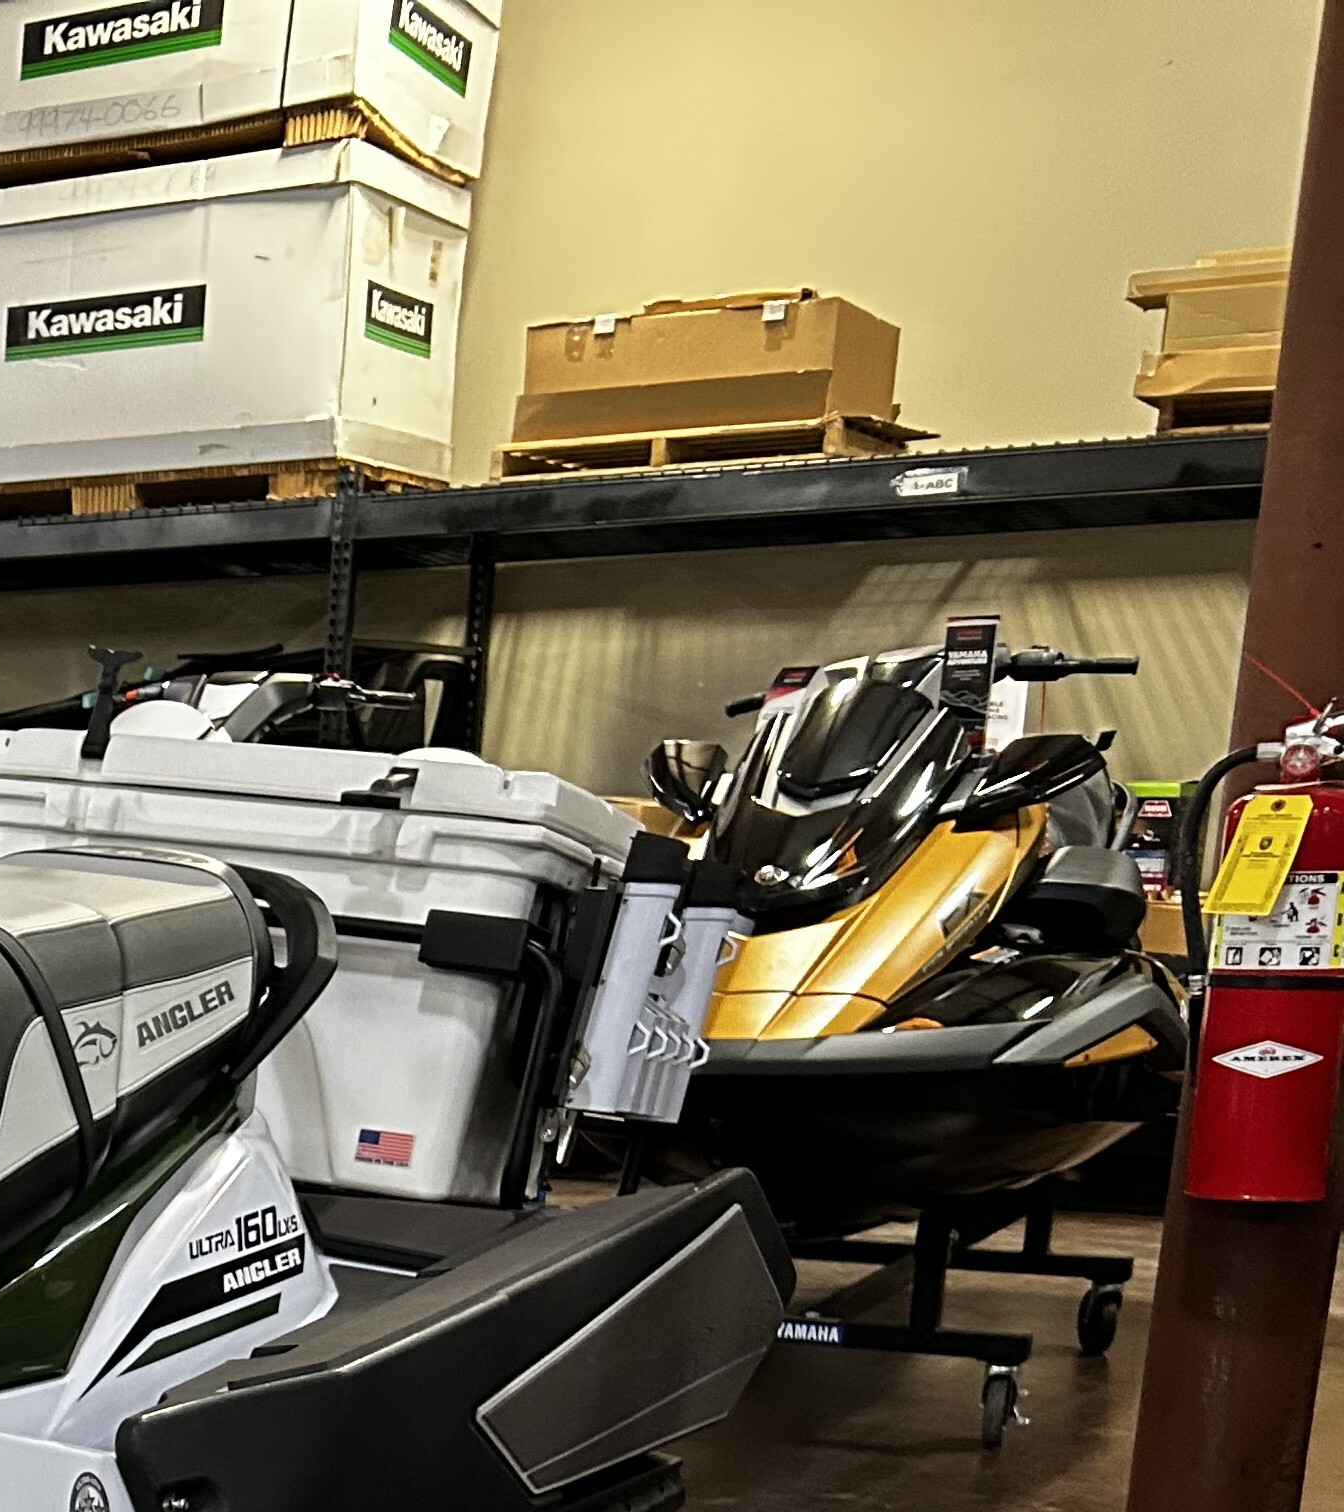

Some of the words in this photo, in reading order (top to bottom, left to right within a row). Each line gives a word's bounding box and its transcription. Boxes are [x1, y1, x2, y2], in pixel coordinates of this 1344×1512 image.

[43, 0, 201, 55] Kawasaki
[399, 0, 464, 72] Kawasaki
[27, 293, 183, 339] Kawasaki
[371, 290, 426, 337] Kawasaki
[136, 980, 234, 1048] ANGLER
[188, 1232, 235, 1260] ULTRA
[223, 1248, 301, 1293] ANGLER
[777, 1322, 839, 1343] YAMAHA
